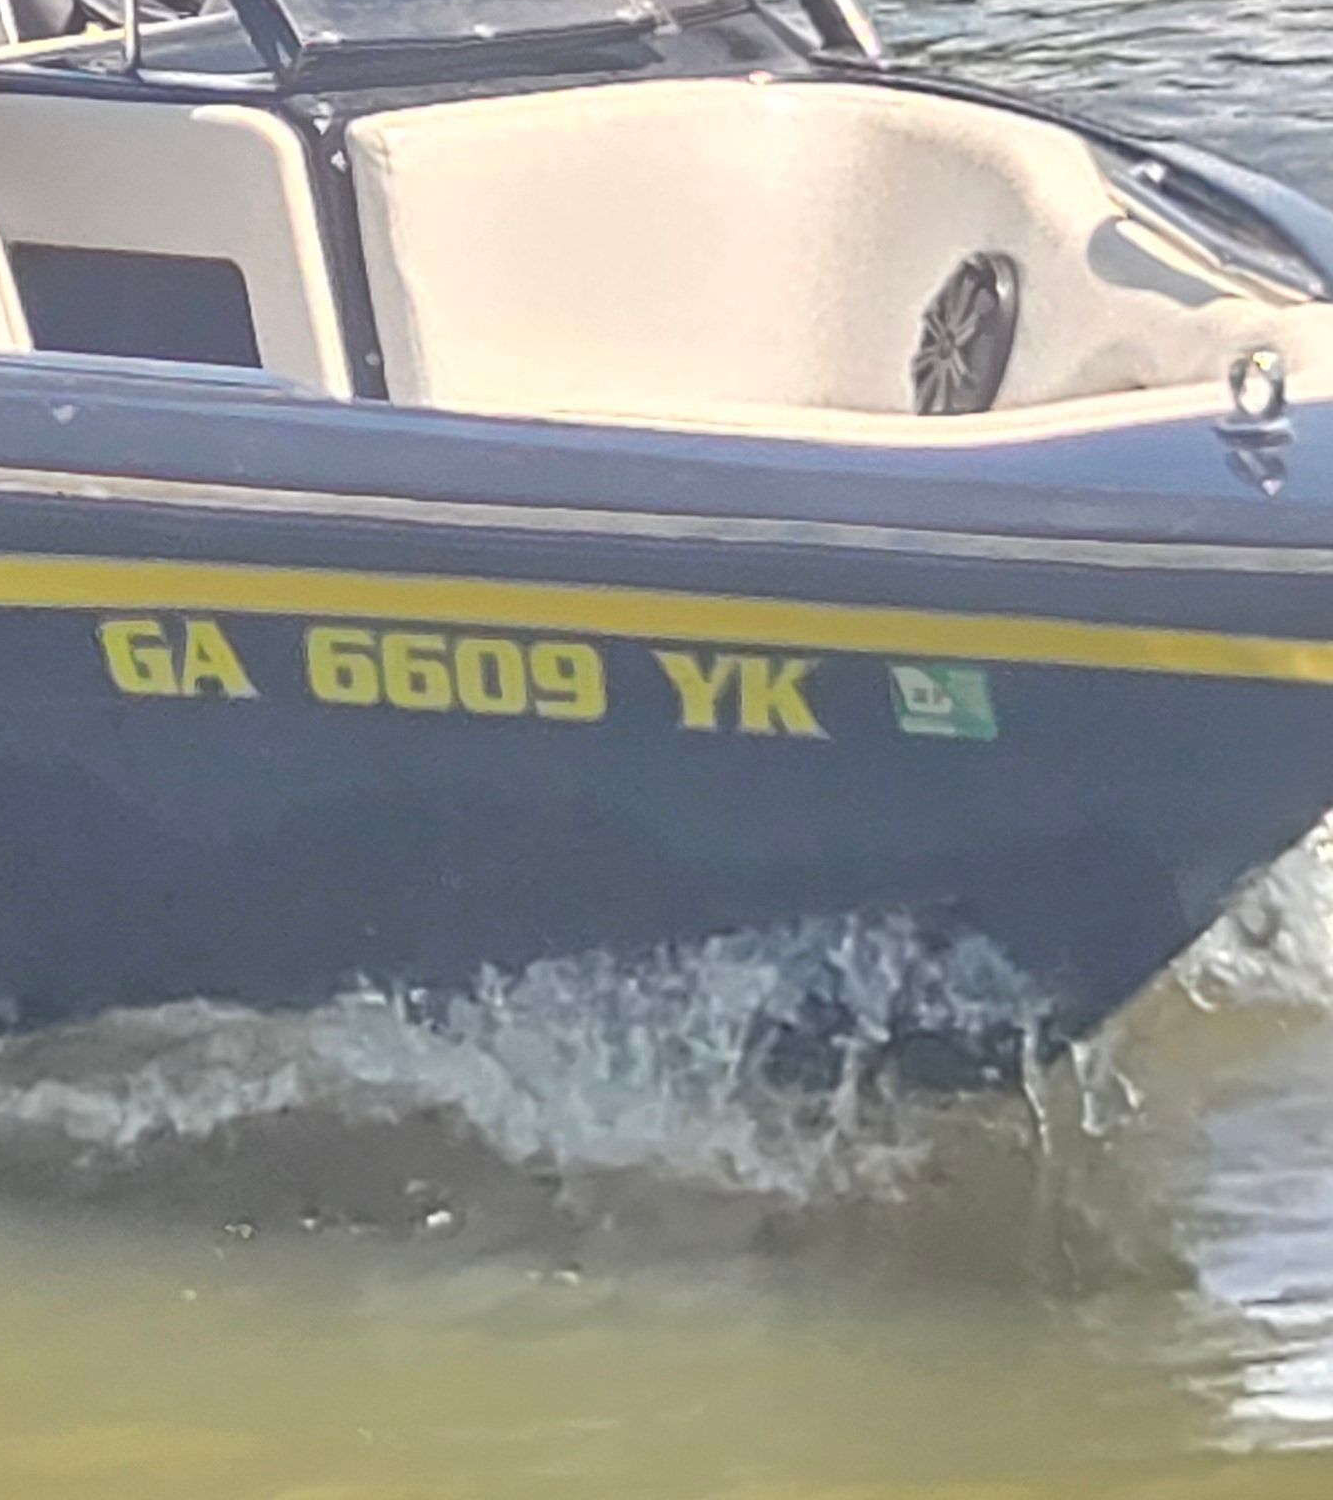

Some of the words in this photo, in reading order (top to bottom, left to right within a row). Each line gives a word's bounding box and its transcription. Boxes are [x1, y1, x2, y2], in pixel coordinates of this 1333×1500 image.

[95, 617, 261, 699] GA
[305, 626, 609, 723] 6609
[649, 649, 832, 740] YK
